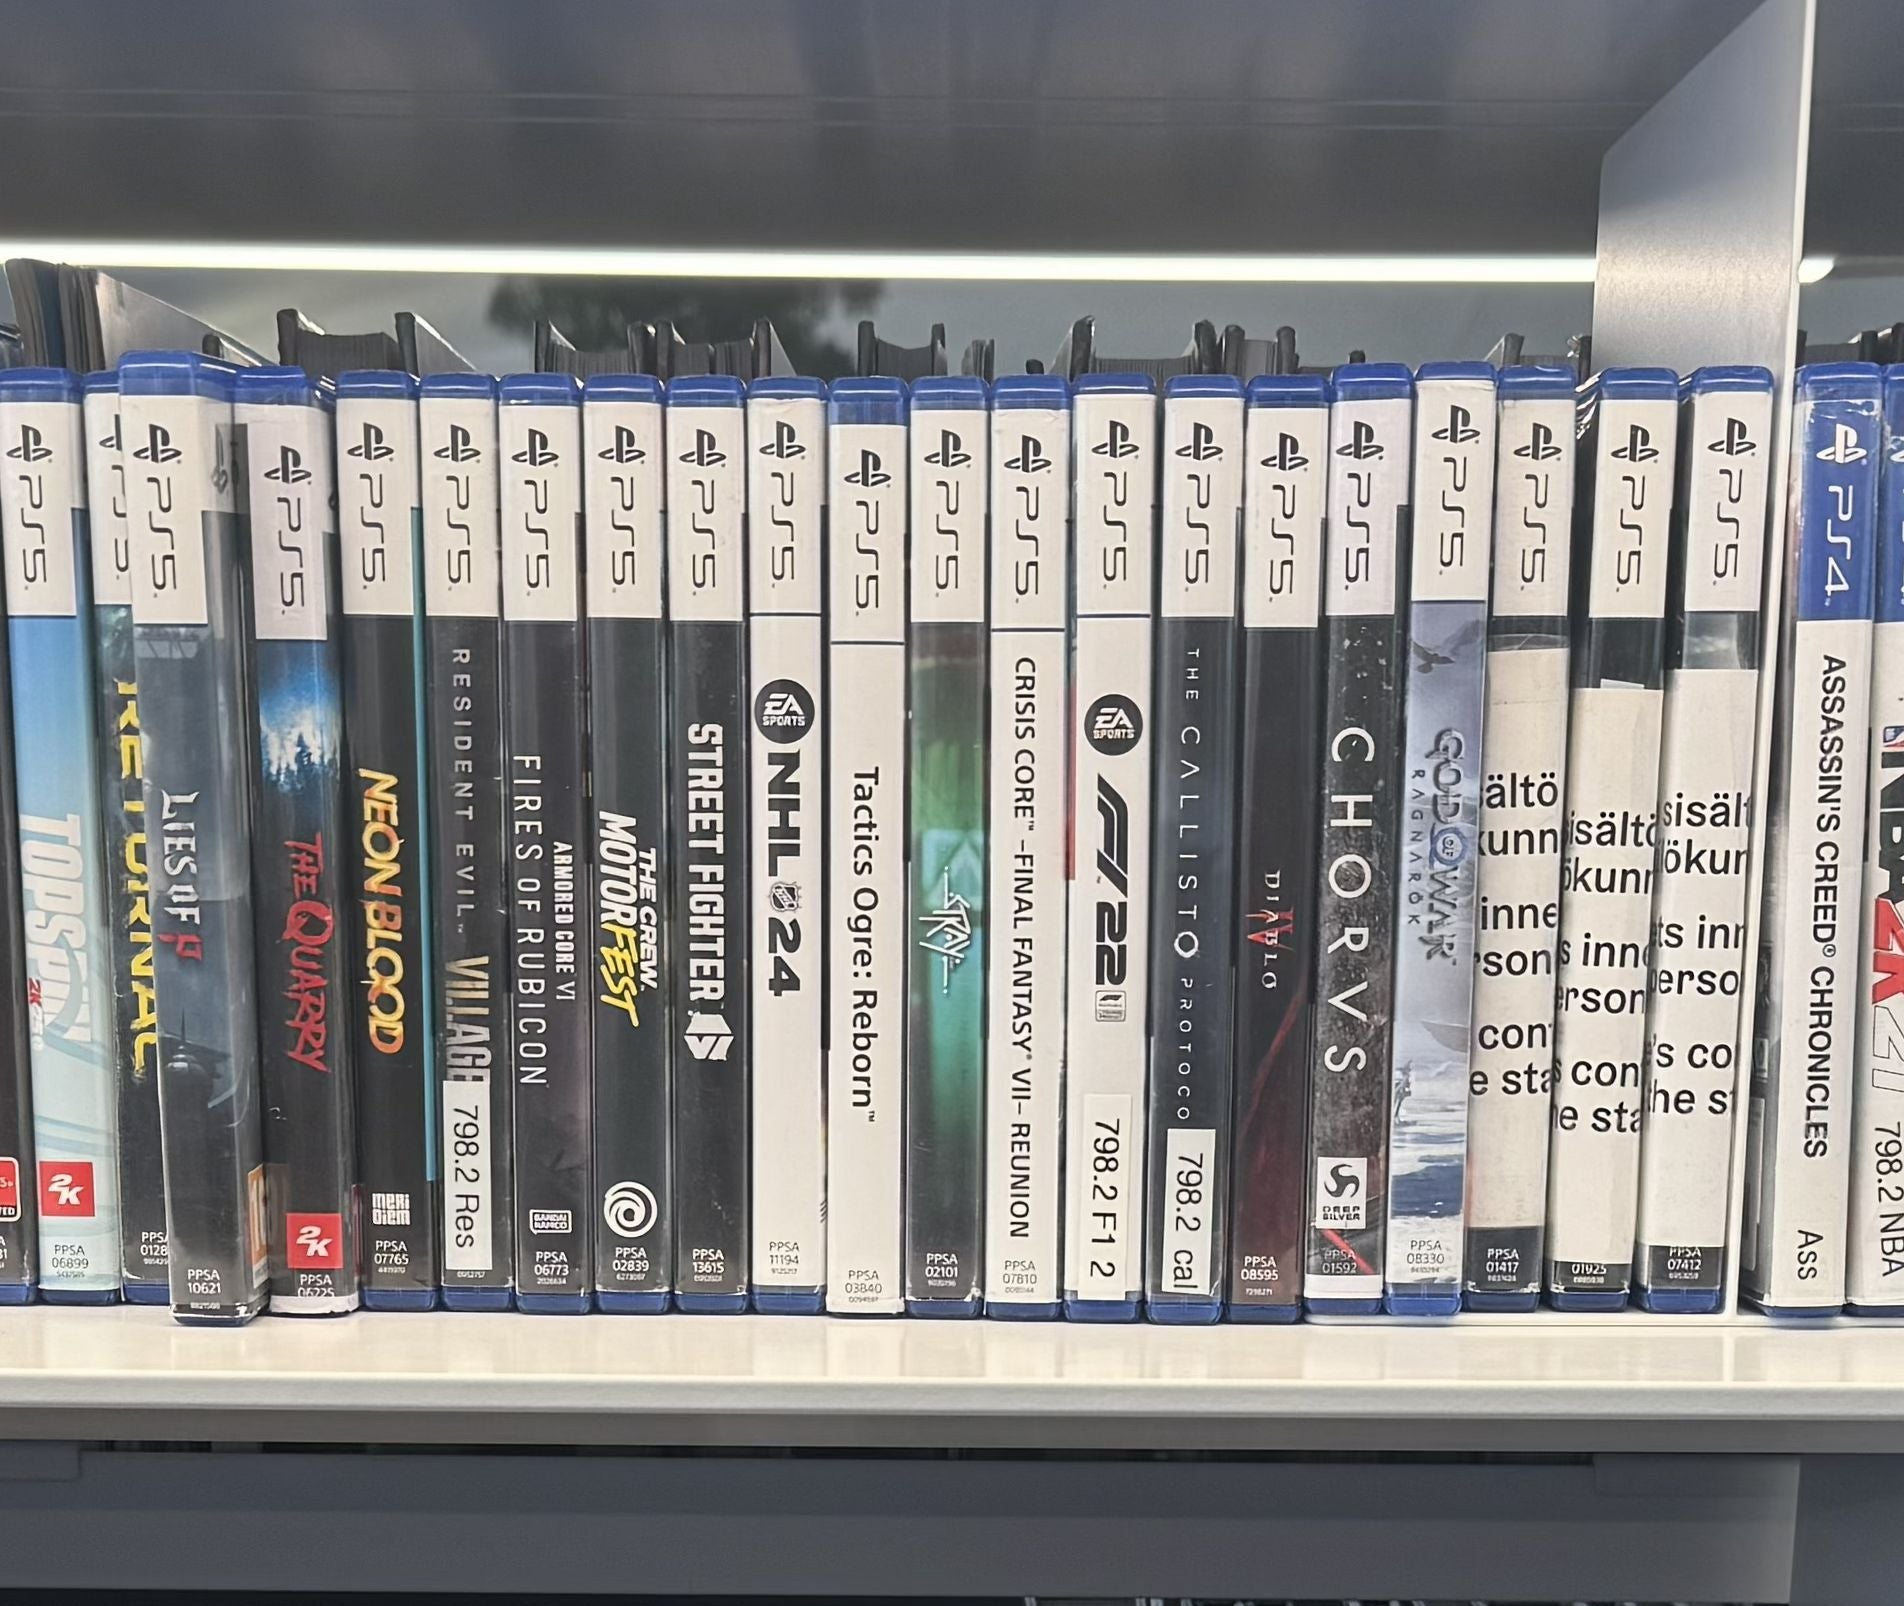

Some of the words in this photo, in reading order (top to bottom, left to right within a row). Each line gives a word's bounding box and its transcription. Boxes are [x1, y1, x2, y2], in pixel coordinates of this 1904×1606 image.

[1816, 654, 1846, 833] ASSASSIN'S
[513, 755, 542, 860] FIRES
[688, 723, 724, 855] STREET
[852, 767, 879, 876] Tactics
[516, 879, 541, 913] OF
[688, 866, 725, 1001] FIGHTER
[848, 888, 879, 978] Ogre:
[1324, 727, 1374, 1074] CHORVS
[767, 917, 802, 996] 24
[517, 929, 548, 1085] RUBICON
[1804, 966, 1835, 1159] CHRONICLES
[453, 1105, 479, 1182] 798.2
[1092, 1119, 1120, 1202] 798.2
[1875, 1121, 1904, 1203] 798.2
[455, 1194, 479, 1248] Res
[1176, 1152, 1204, 1234] 798.2
[535, 1264, 569, 1276] 06773
[536, 1251, 568, 1263] PPSA
[1172, 1250, 1199, 1290] cal
[1797, 1229, 1824, 1281] Ass
